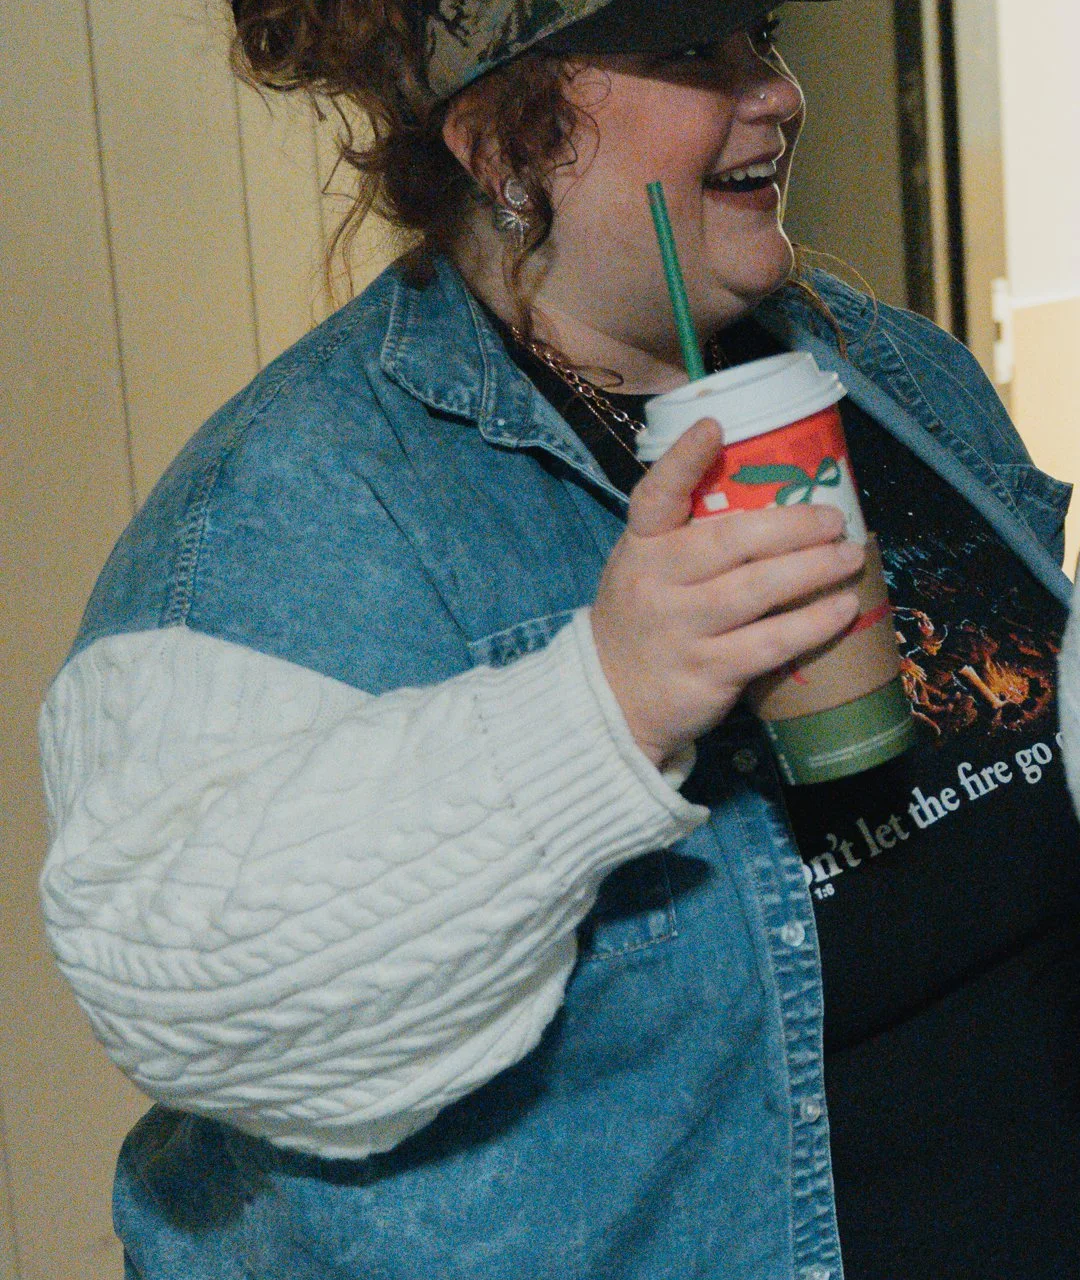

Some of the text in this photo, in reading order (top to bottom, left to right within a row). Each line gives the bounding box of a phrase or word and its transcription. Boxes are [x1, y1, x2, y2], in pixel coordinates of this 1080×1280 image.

[856, 816, 911, 857] let
[907, 786, 961, 829] the
[956, 761, 1014, 801] fire
[1014, 742, 1053, 785] go
